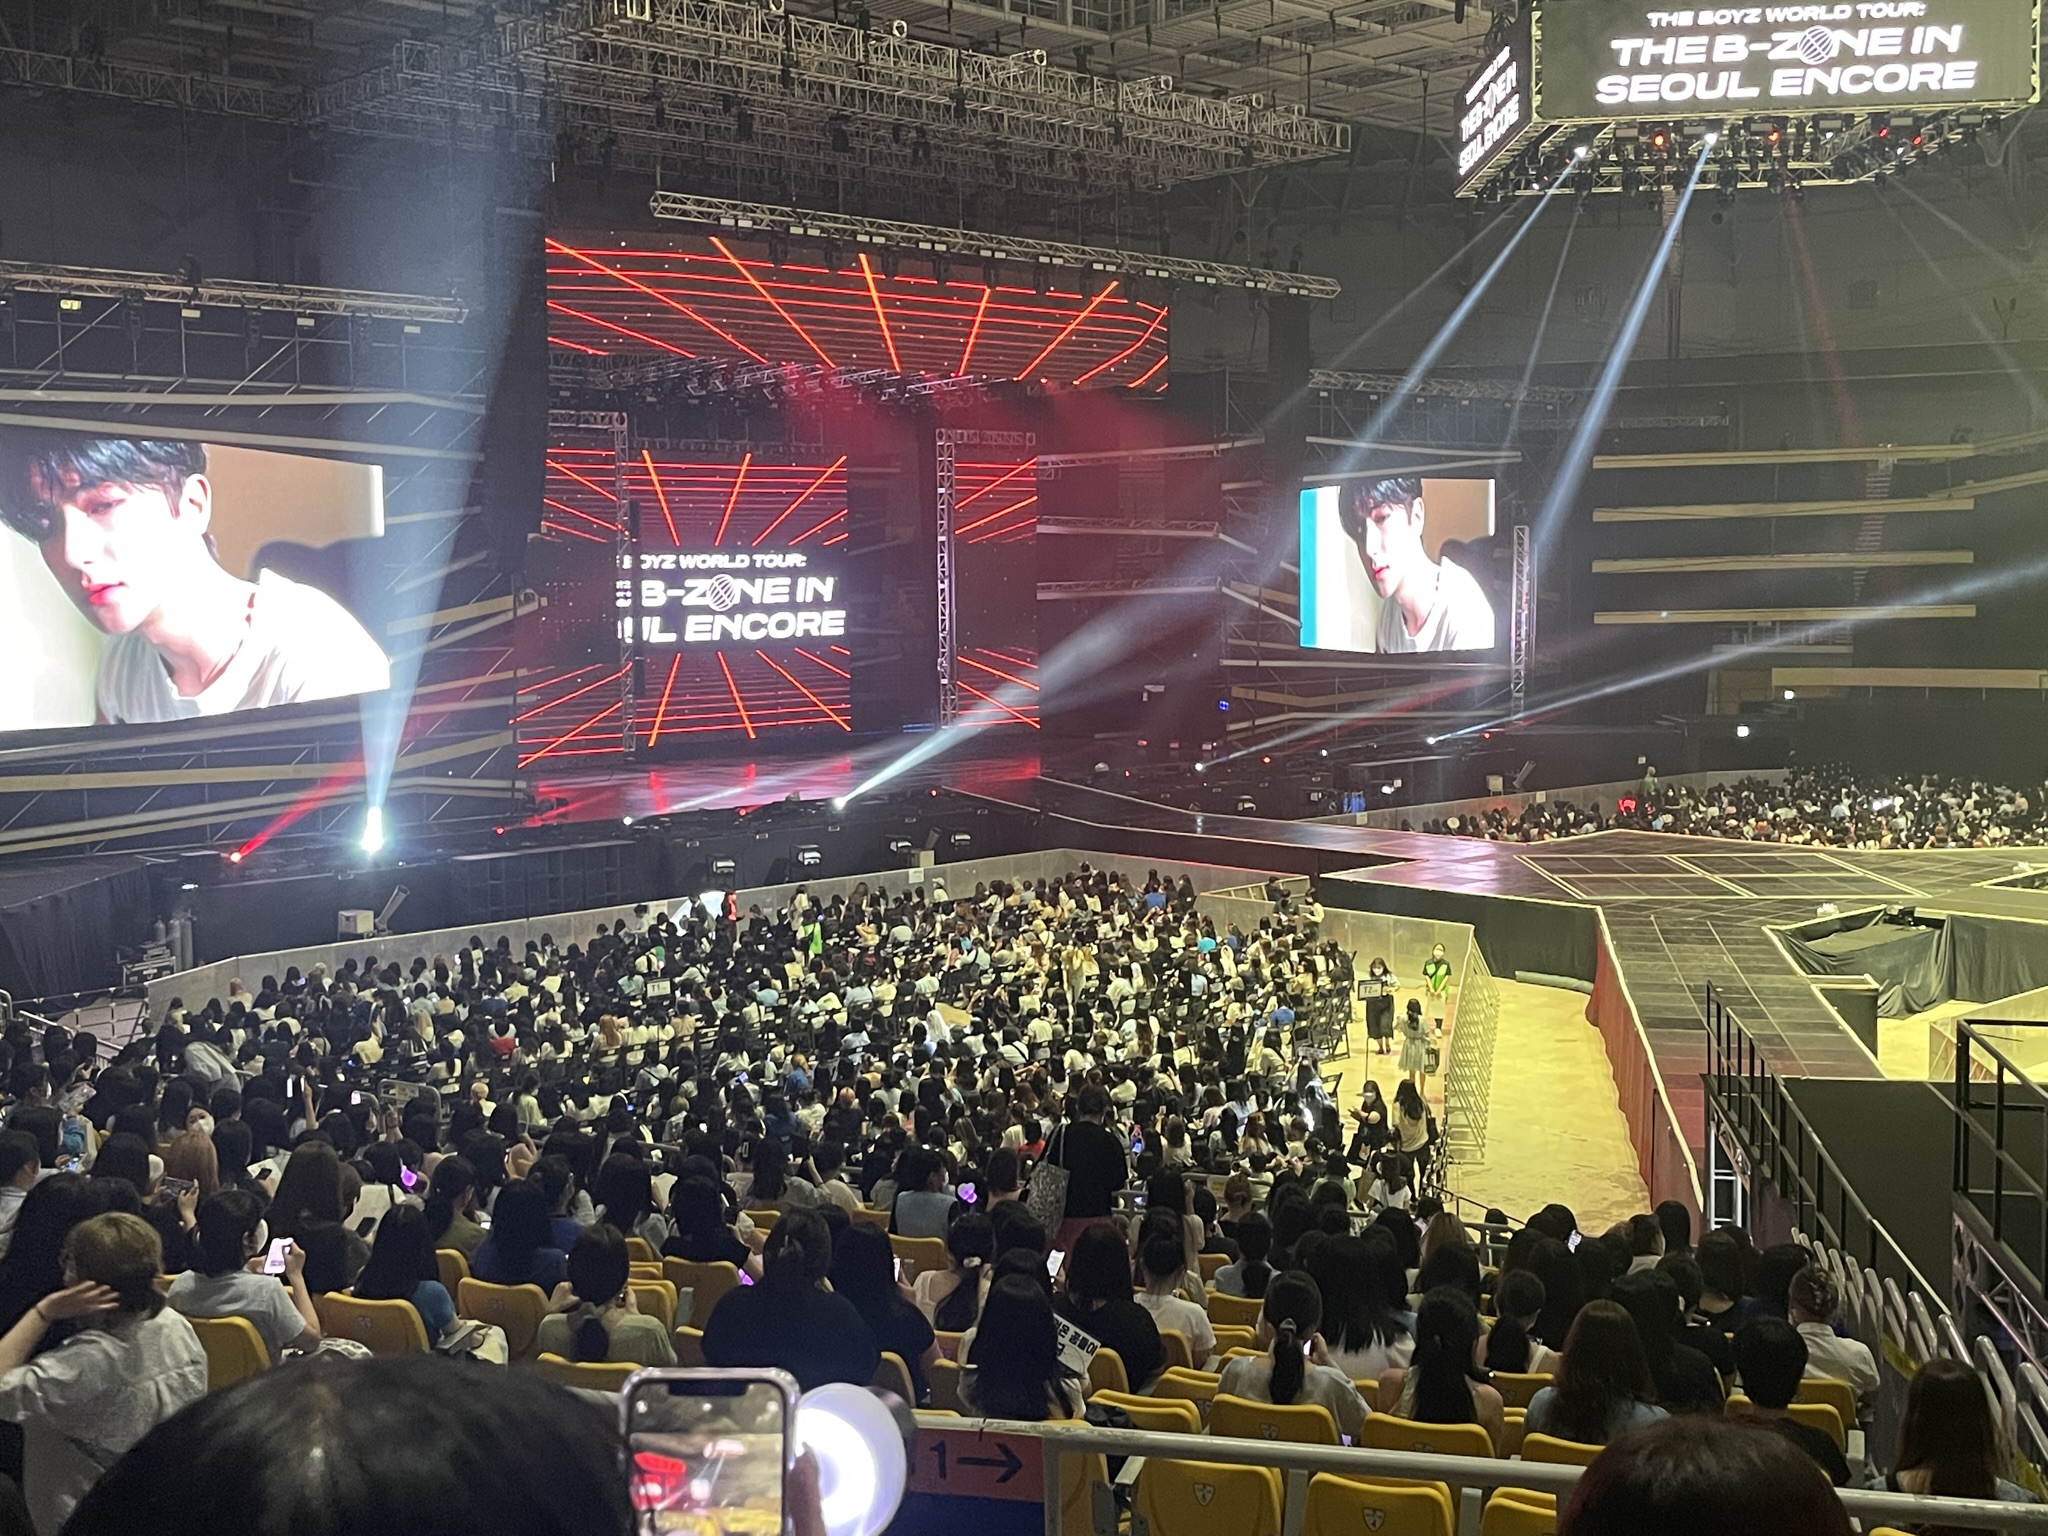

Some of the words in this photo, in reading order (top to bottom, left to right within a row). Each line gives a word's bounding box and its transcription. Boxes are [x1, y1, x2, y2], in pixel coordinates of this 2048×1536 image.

[1646, 12, 1695, 28] THE
[1697, 8, 1762, 25] BOYZ
[1765, 4, 1852, 23] WORLD
[1855, 1, 1926, 19] TOUR:
[1610, 36, 1709, 67] THE
[1910, 24, 1963, 54] IN
[1595, 71, 1760, 104] SEOUL
[1769, 60, 1978, 97] ENCORE
[678, 554, 750, 569] WORLD
[752, 553, 807, 568] TOUR:
[796, 577, 834, 602] IN
[684, 610, 846, 641] ENCORE
